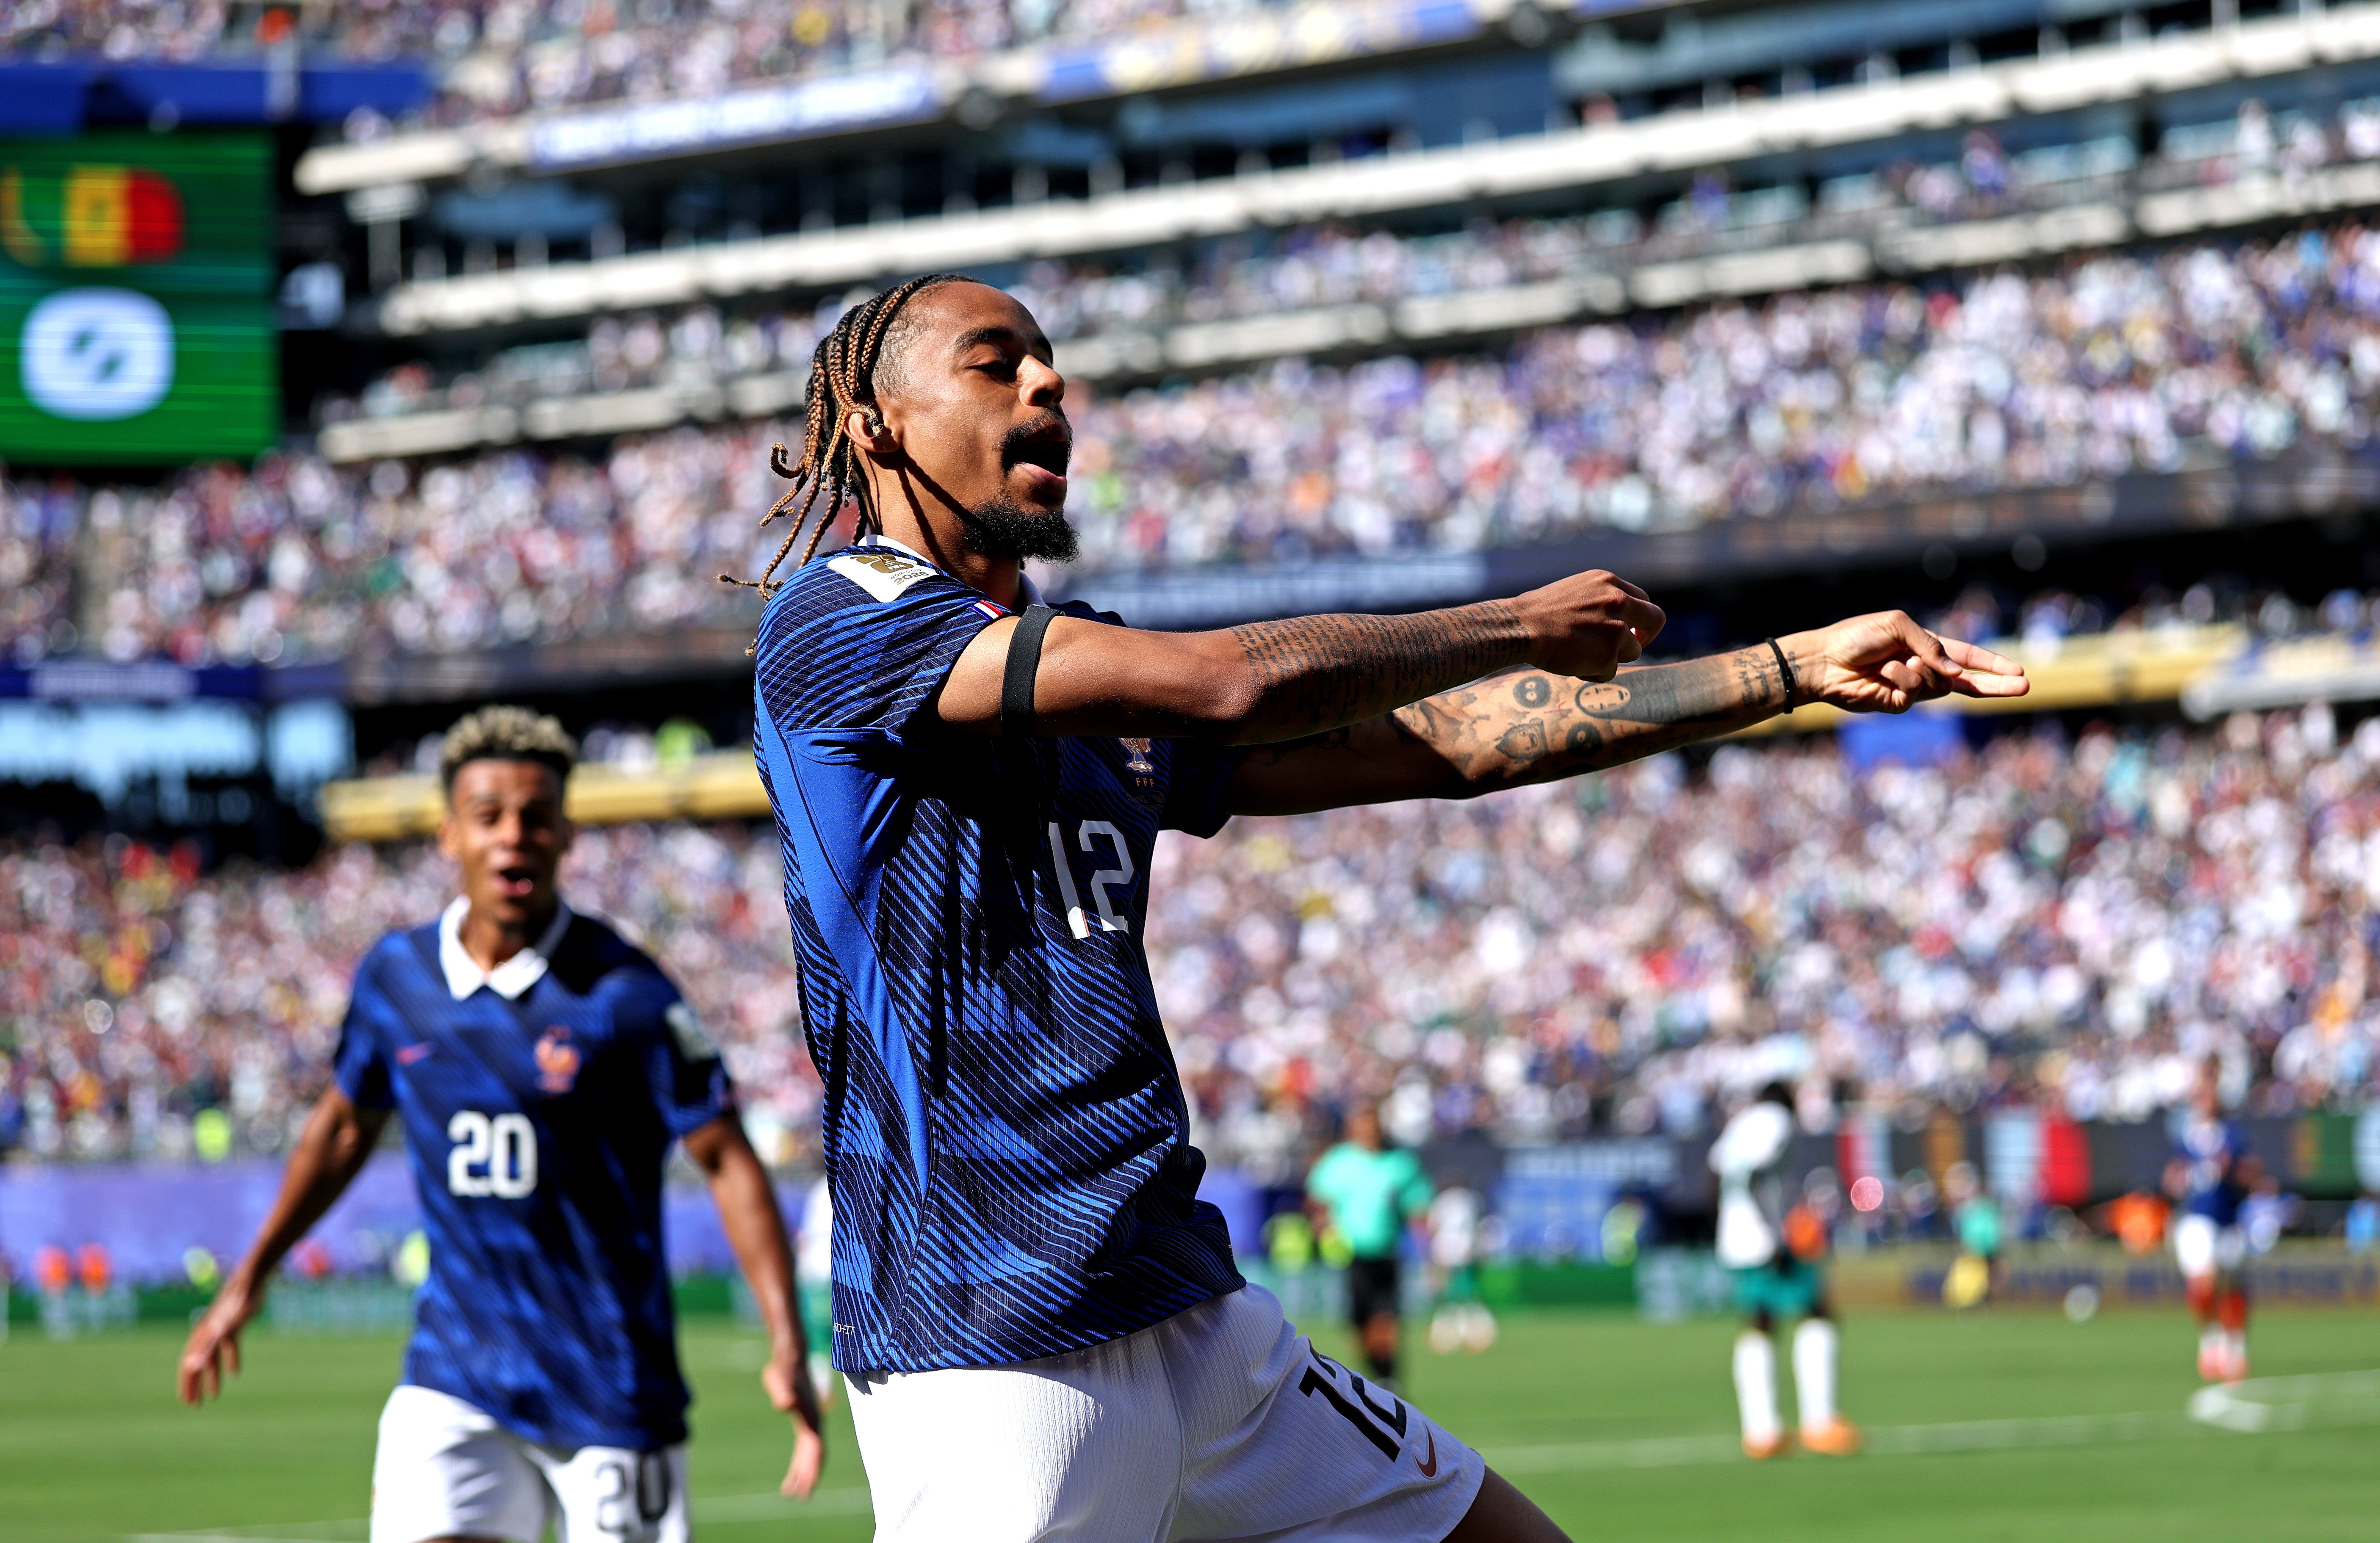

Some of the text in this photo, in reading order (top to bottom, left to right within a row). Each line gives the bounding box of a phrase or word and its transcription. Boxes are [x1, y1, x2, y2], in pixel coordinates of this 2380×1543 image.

[888, 570, 910, 580] WORLD
[894, 572, 929, 585] 2026
[1048, 820, 1136, 939] 12
[448, 1110, 537, 1199] 20
[1298, 1338, 1407, 1463] 12
[596, 1452, 672, 1533] 20
